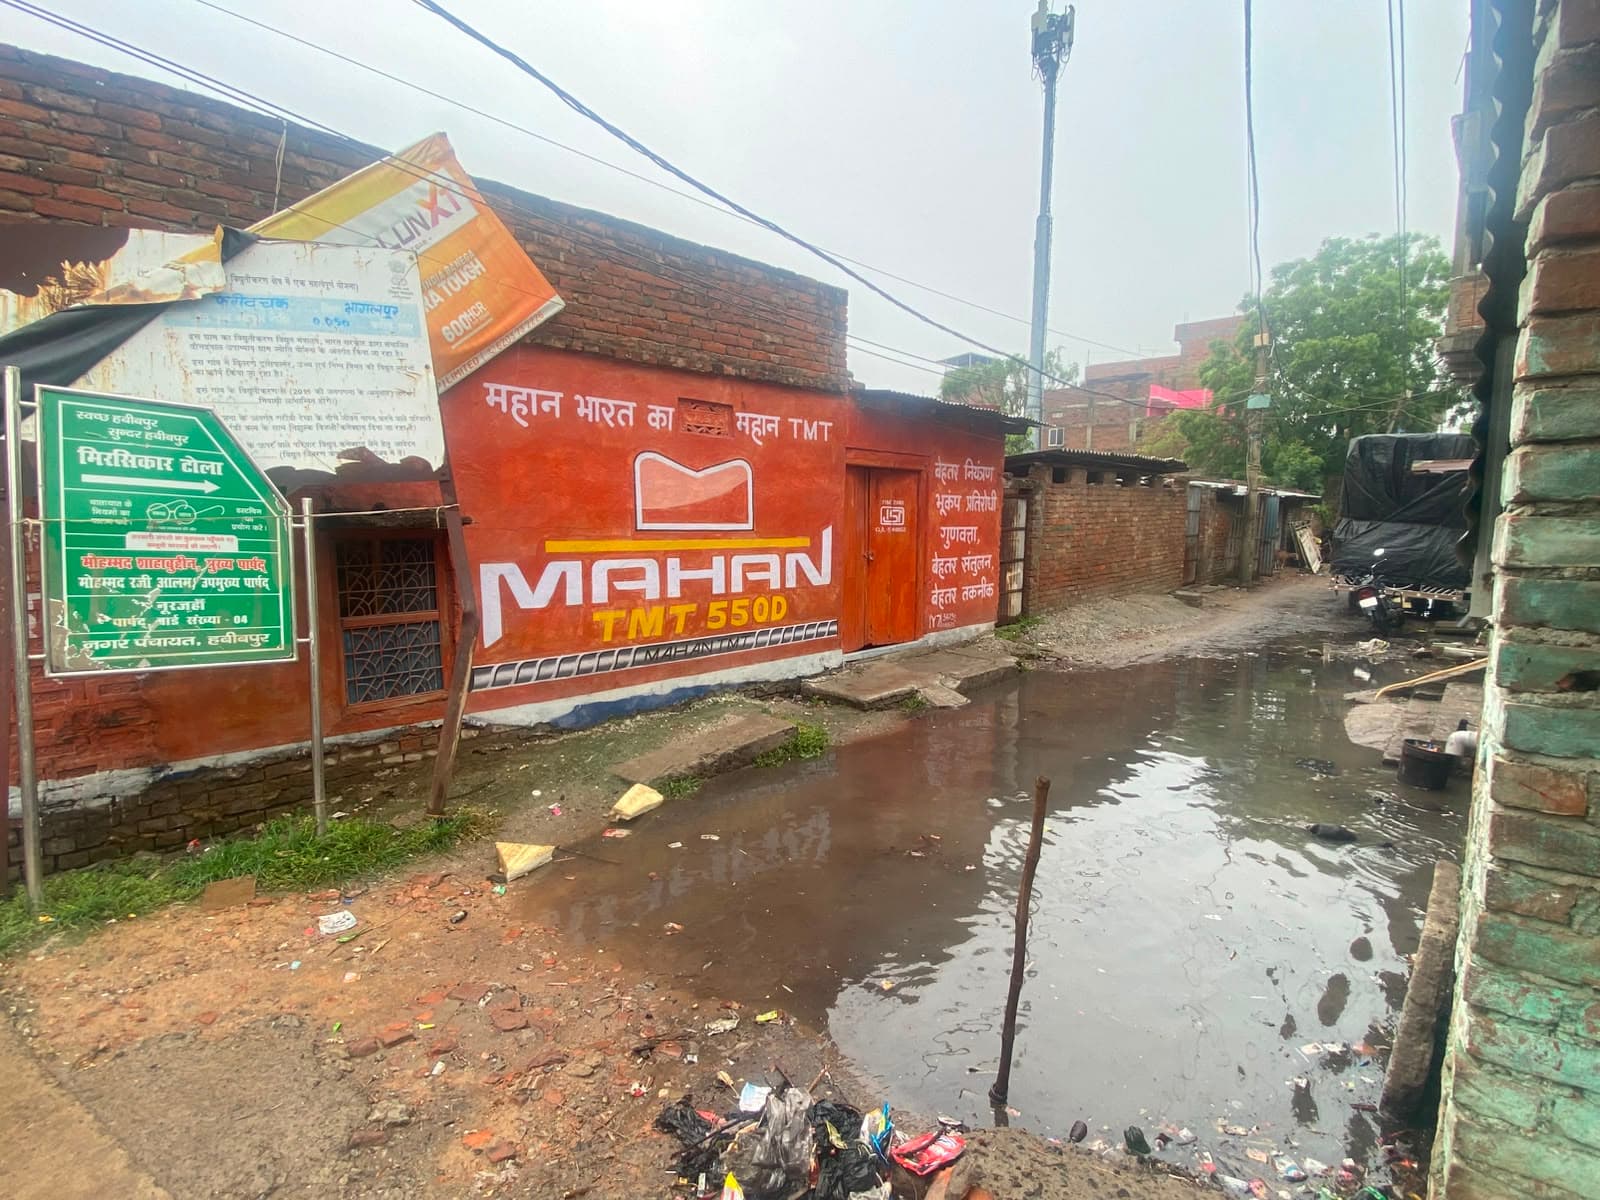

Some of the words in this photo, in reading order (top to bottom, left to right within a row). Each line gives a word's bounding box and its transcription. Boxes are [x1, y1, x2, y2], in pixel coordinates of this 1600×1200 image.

[440, 258, 487, 299] TOUGH
[483, 382, 563, 427] महान
[574, 394, 637, 428] भारत
[647, 404, 676, 431] का
[735, 411, 781, 445] महान
[788, 418, 834, 442] TMT
[179, 455, 224, 476] टोला
[936, 489, 962, 517] भूकंप
[966, 489, 998, 512] प्रतिरोधी
[80, 553, 133, 569] मोहम्मद
[77, 574, 126, 588] मोहम्मद
[128, 574, 152, 588] रजी
[480, 525, 833, 648] MAHAN
[962, 576, 994, 601] तकनीक
[186, 614, 221, 625] संख्या
[234, 615, 248, 624] 04
[592, 603, 697, 642] TMT
[707, 595, 788, 630] 550D
[82, 639, 130, 650] नगर
[645, 640, 714, 661] MAHAN
[718, 636, 752, 651] TMT
